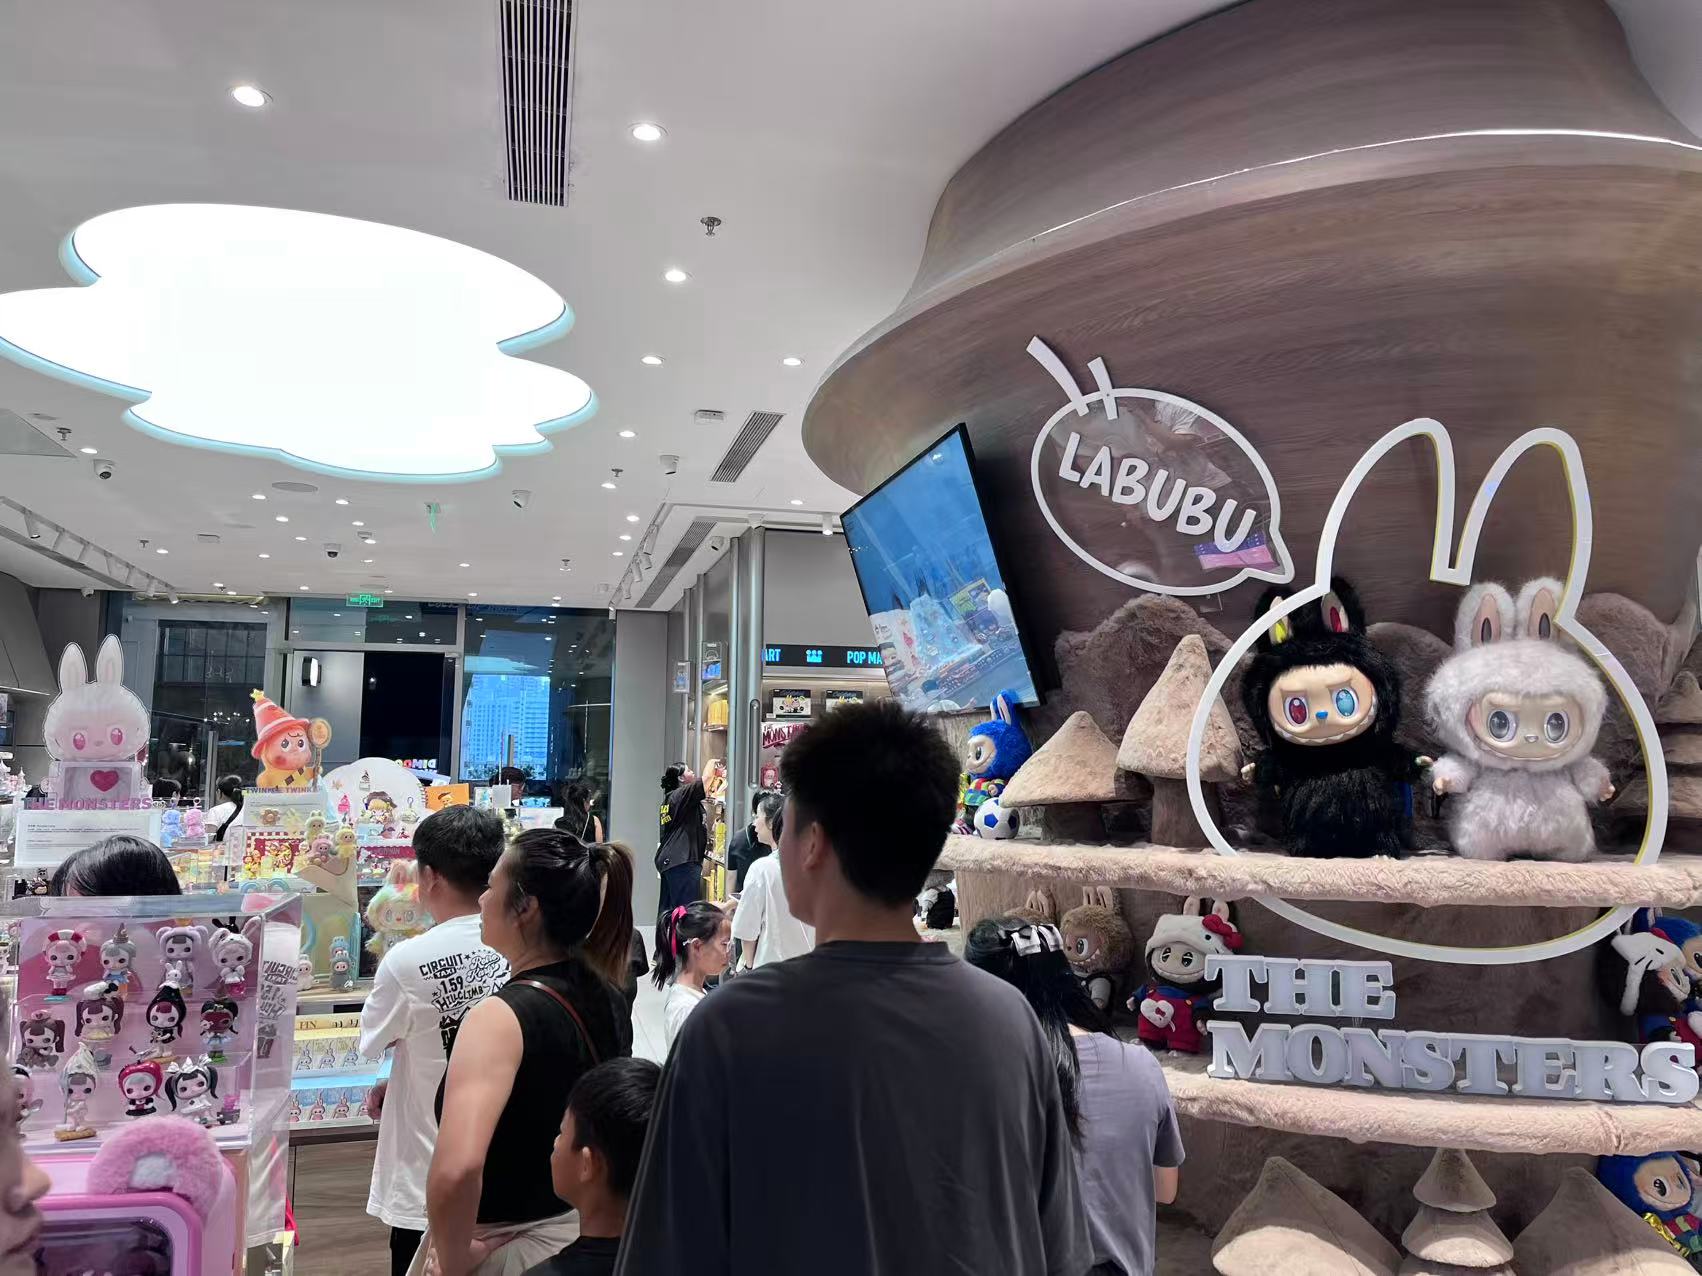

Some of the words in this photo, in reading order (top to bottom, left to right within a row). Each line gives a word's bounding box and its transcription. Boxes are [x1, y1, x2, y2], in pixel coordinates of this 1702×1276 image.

[1058, 431, 1257, 553] LABUBU
[847, 651, 866, 664] POP
[419, 953, 463, 976] CIRCUIT
[434, 967, 457, 979] TAXI
[440, 976, 464, 995] 1.59
[1204, 954, 1396, 1020] THE
[1205, 1020, 1700, 1103] MONSTERS
